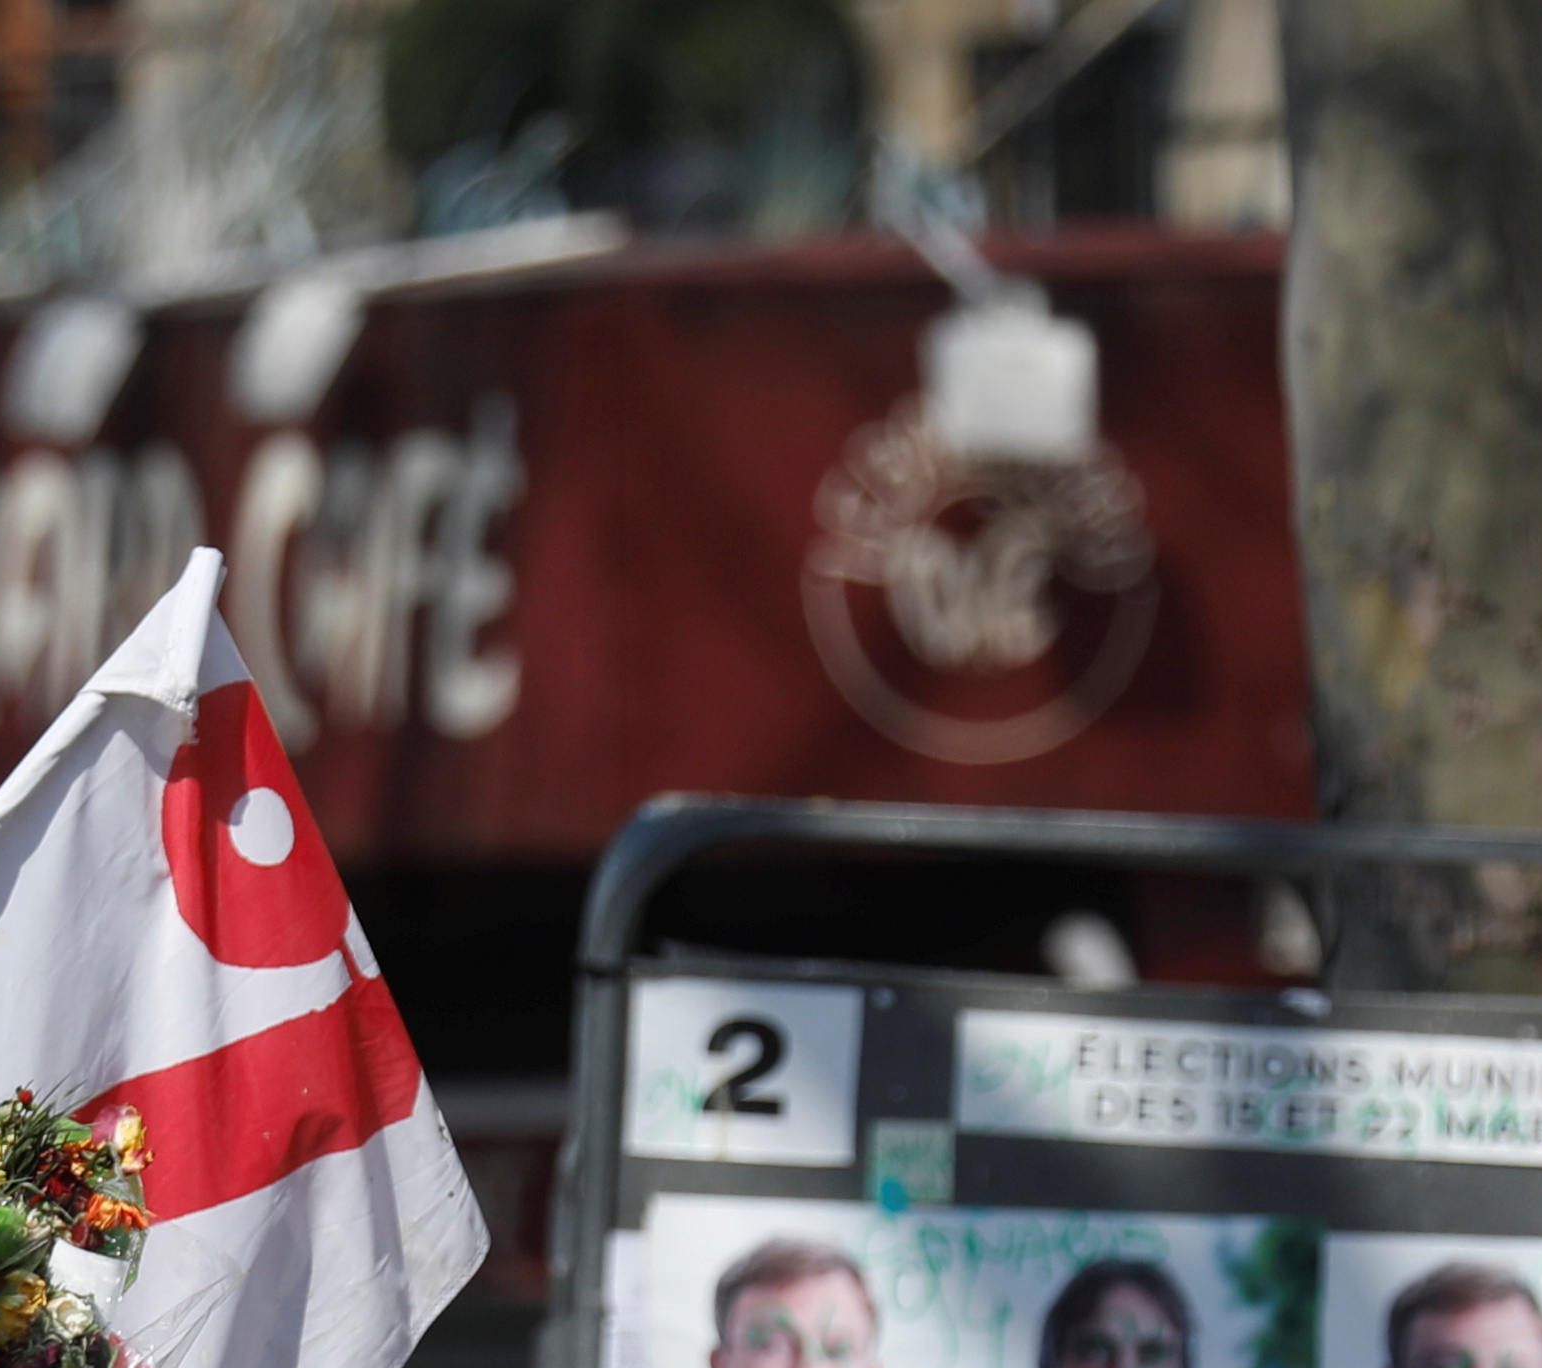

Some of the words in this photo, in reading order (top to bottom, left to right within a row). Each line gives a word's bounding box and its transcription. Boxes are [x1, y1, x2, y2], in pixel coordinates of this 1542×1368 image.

[701, 1020, 792, 1116] 2
[1096, 1086, 1195, 1125] DES
[1223, 1094, 1260, 1128] 15
[1287, 1096, 1337, 1130] ET
